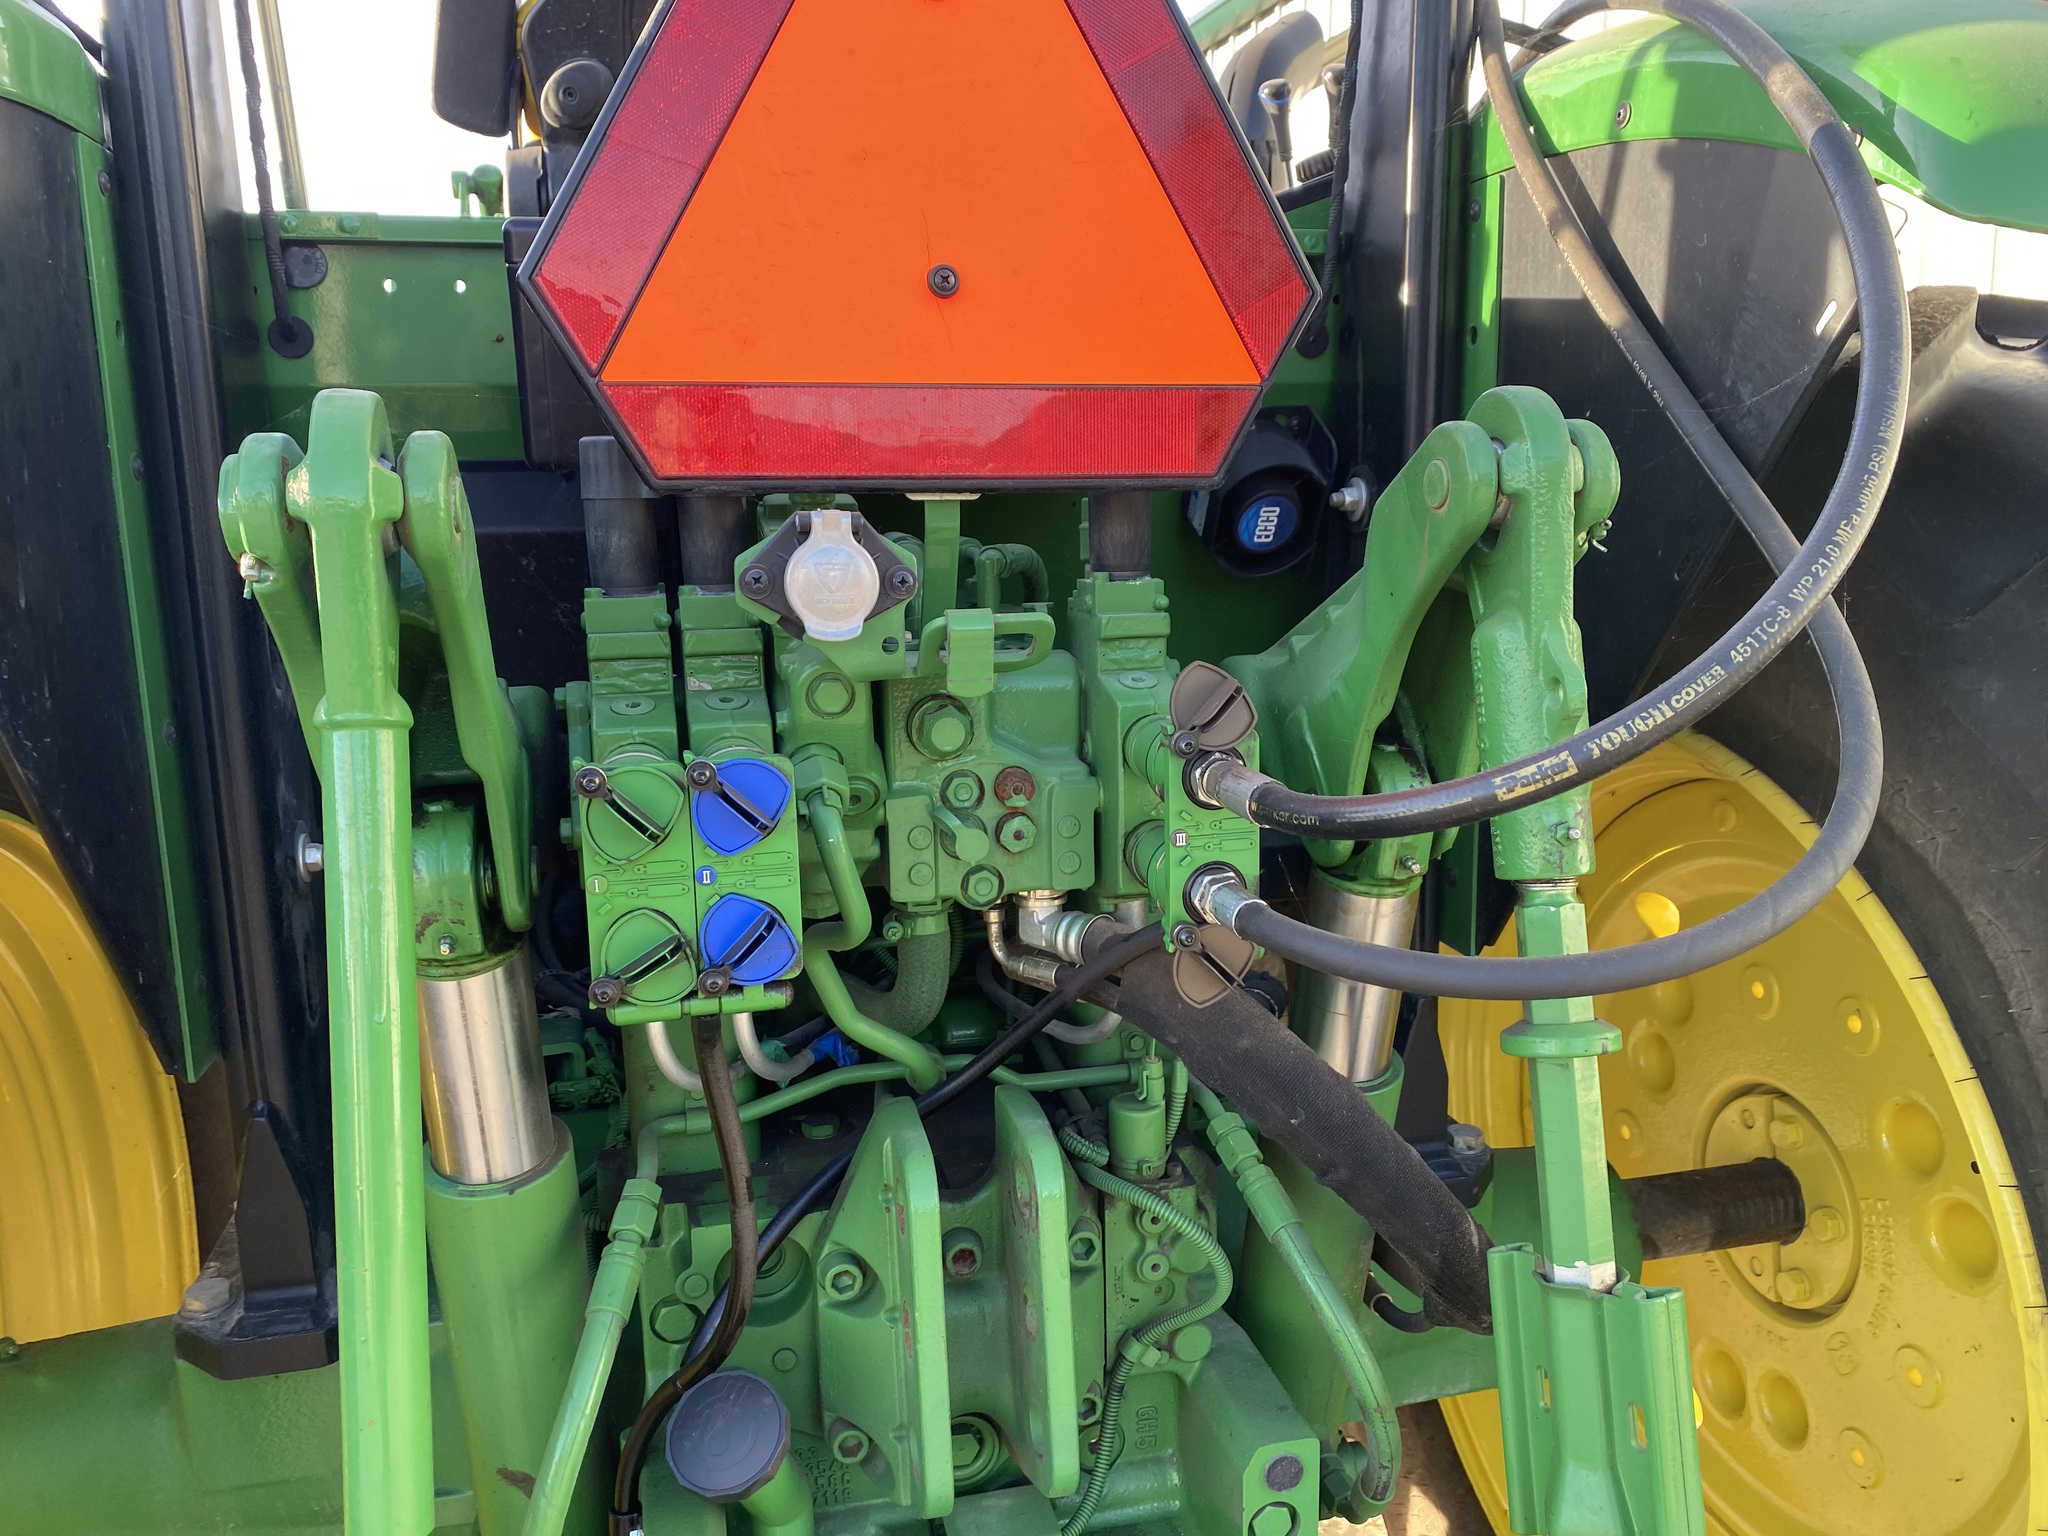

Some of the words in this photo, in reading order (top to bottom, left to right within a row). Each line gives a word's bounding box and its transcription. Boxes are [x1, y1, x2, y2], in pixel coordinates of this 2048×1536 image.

[1253, 506, 1280, 543] ECCO
[1497, 756, 1573, 795] Parker
[1729, 605, 1791, 665] 451TC-8
[1788, 575, 1814, 602] WP
[1811, 543, 1841, 578] 21.0
